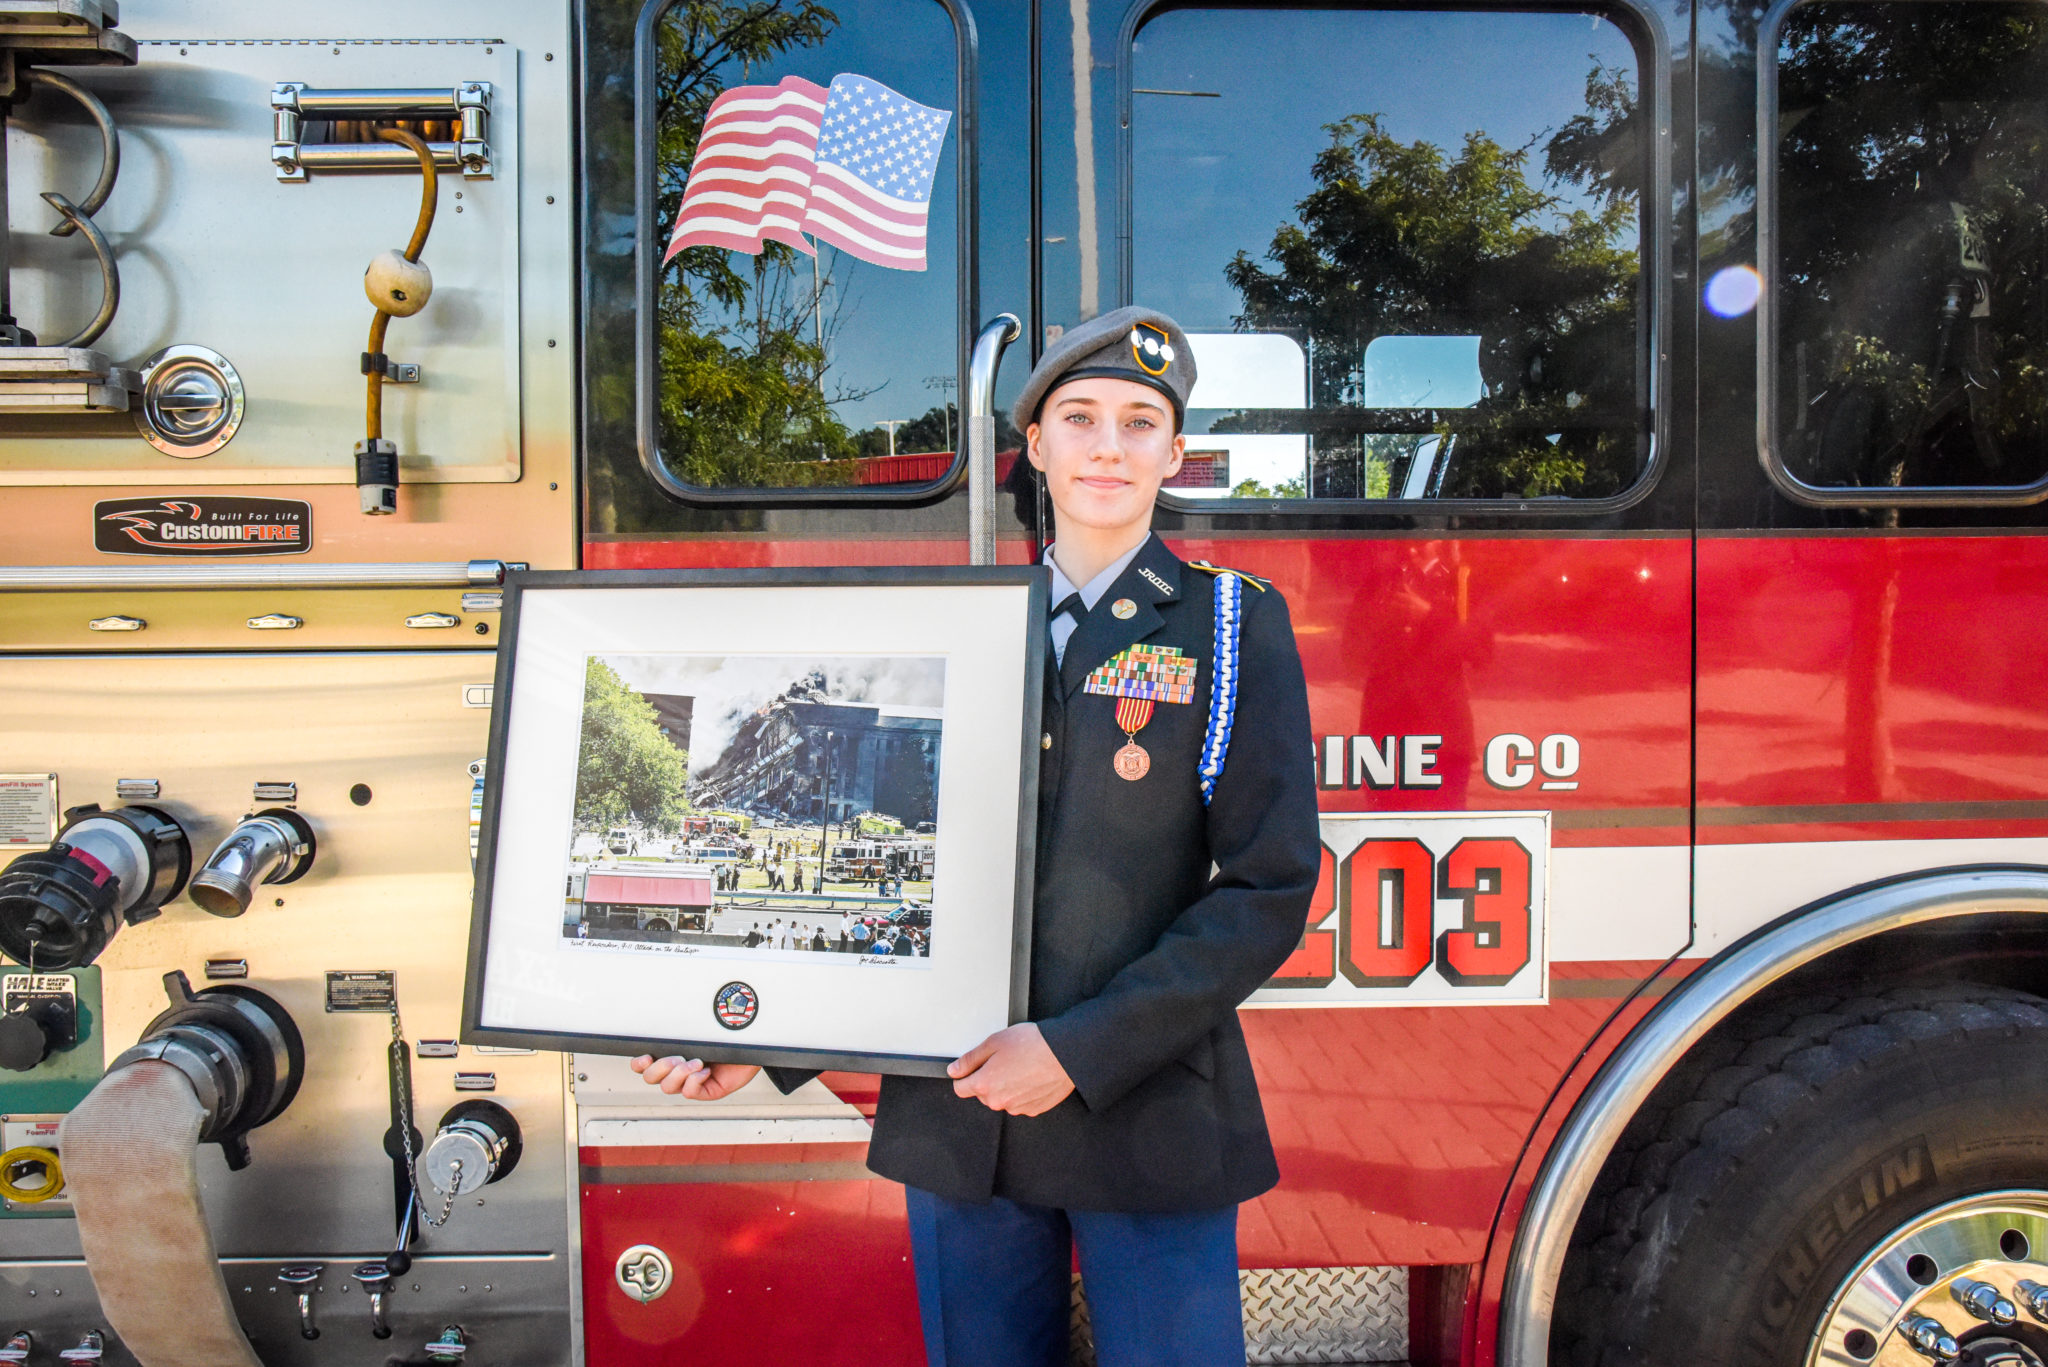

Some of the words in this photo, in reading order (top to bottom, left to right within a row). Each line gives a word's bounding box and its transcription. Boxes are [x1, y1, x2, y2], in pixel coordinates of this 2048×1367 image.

[211, 513, 243, 521] Built
[249, 513, 269, 521] For
[275, 513, 300, 521] Life
[160, 522, 301, 541] CustomFIRE
[1137, 567, 1175, 597] JROTC
[1311, 734, 1443, 791] INE
[1256, 836, 1533, 989] 203
[7, 977, 45, 989] HALE
